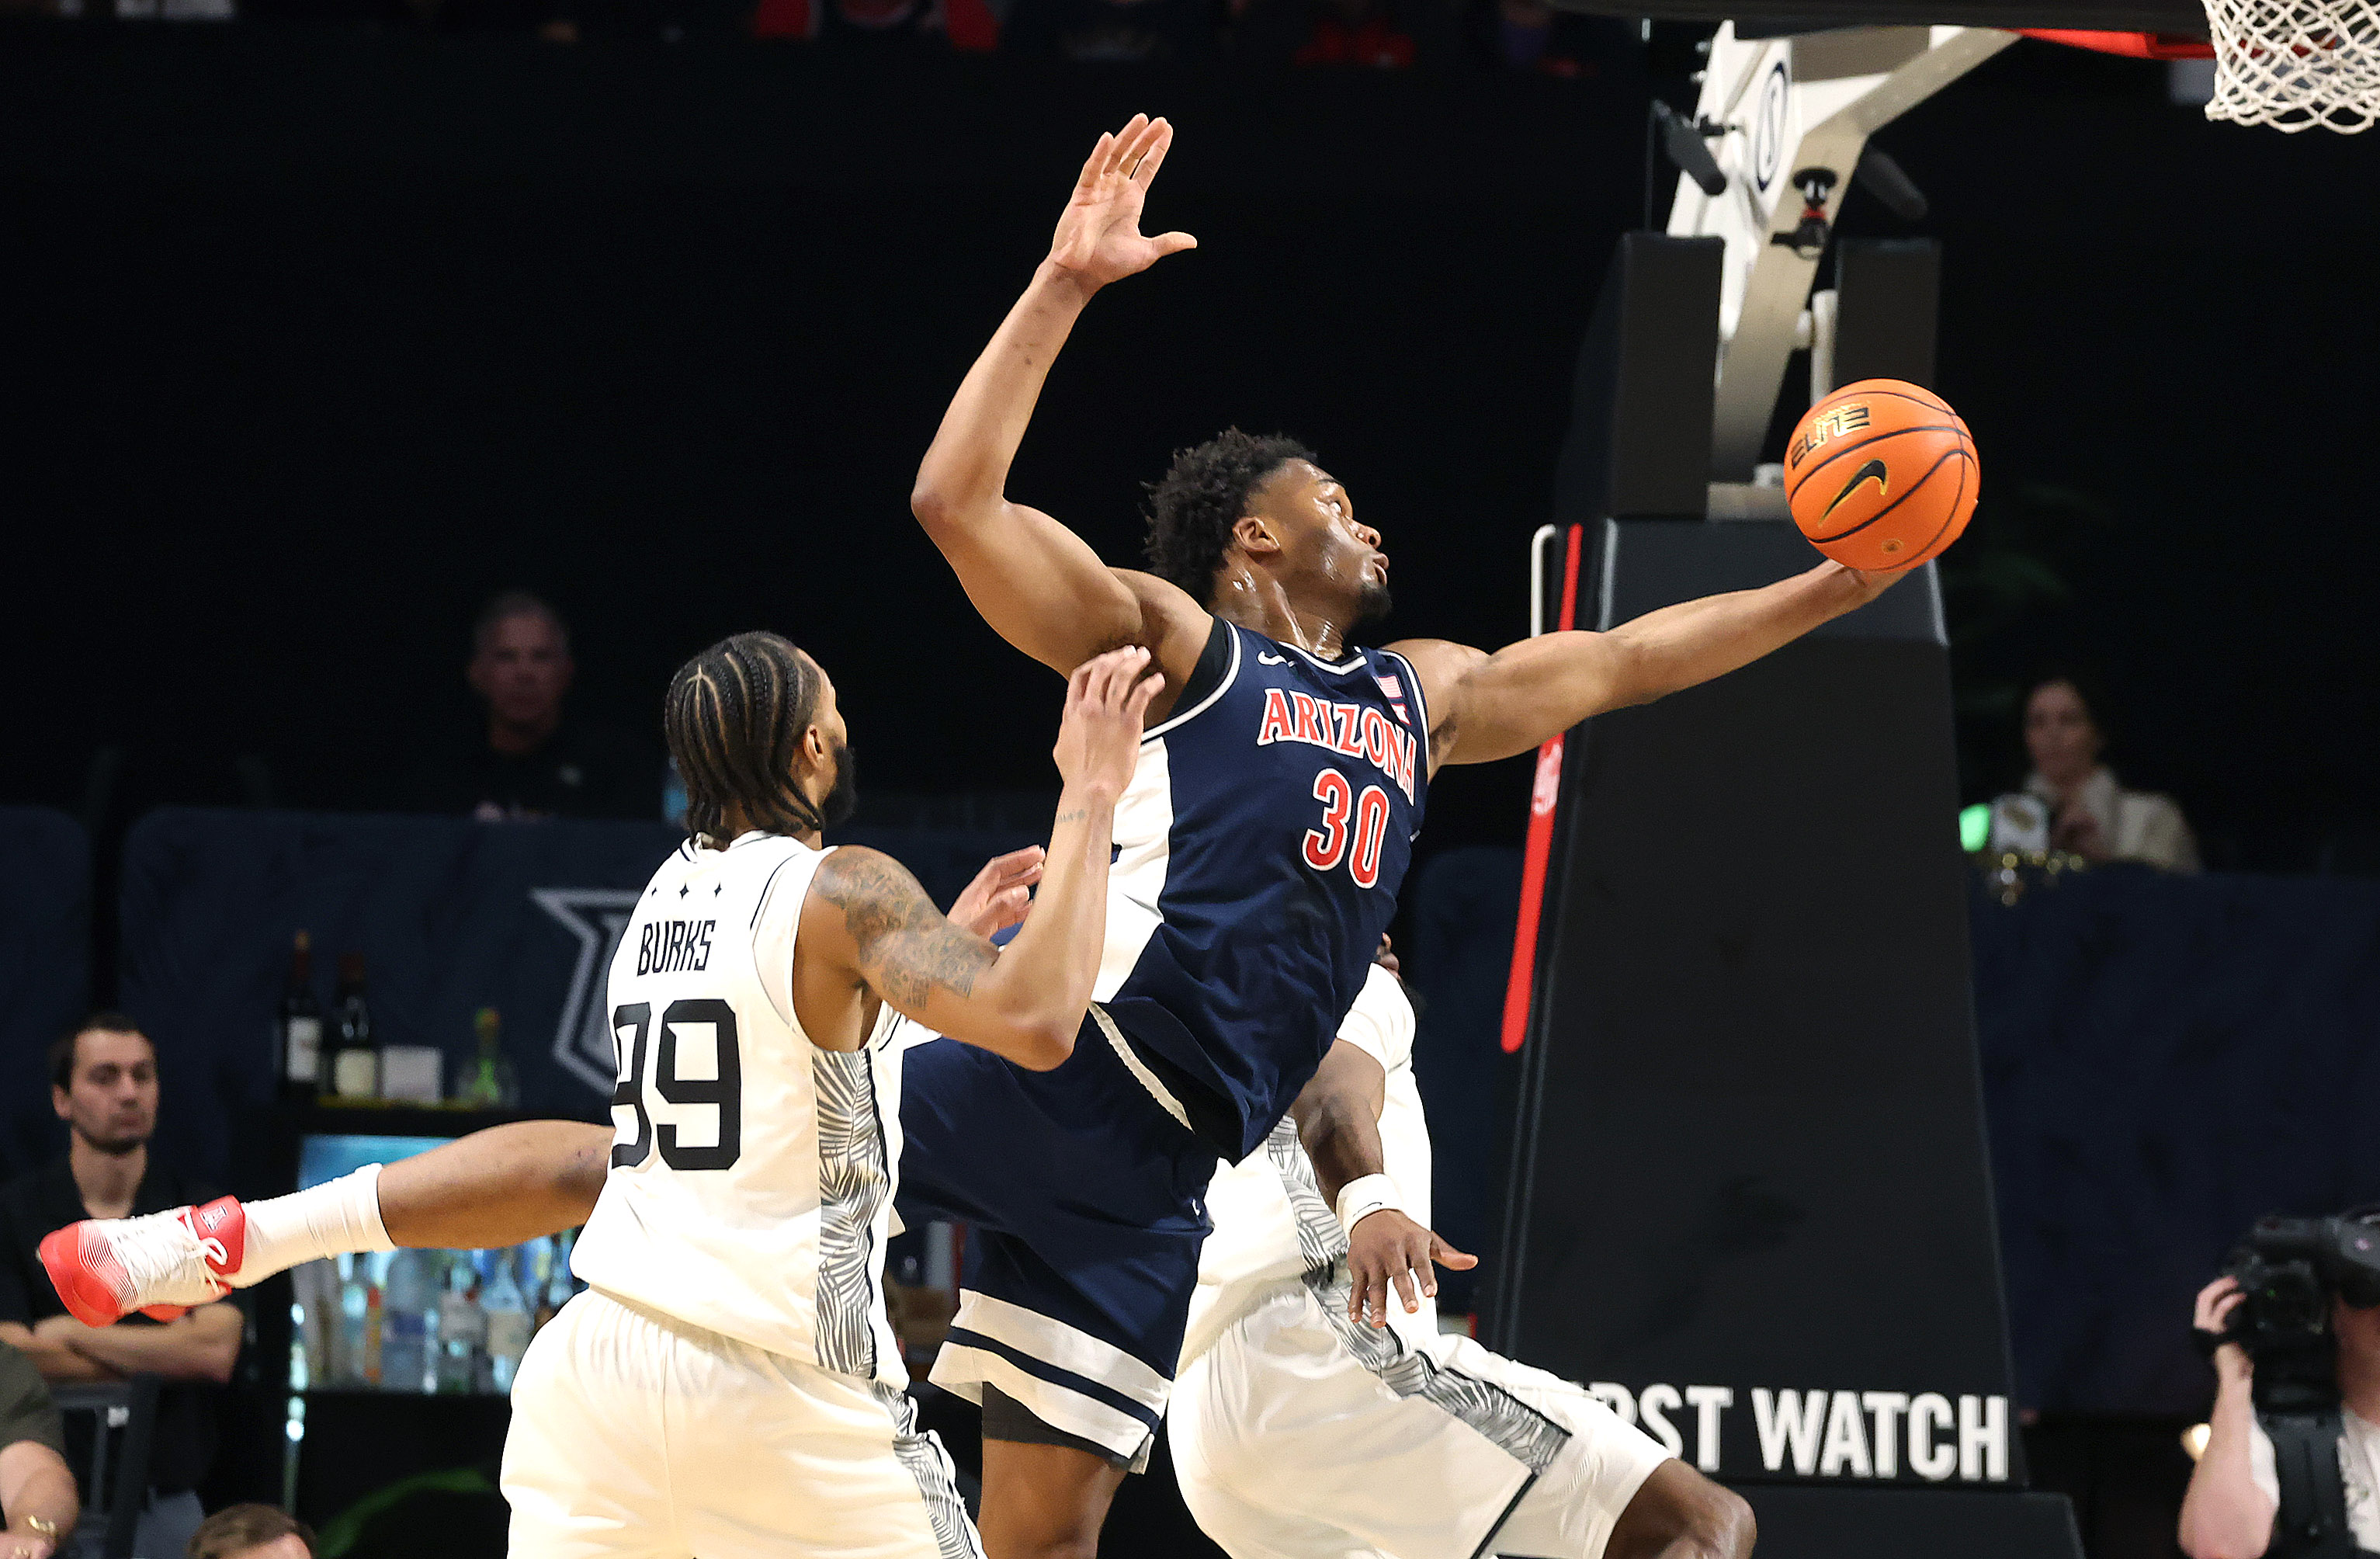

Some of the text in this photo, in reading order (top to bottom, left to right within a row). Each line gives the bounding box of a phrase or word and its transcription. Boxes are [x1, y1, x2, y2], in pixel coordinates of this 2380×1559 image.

[1790, 402, 1872, 470] ELITE
[1257, 688, 1417, 807] ARIZONA
[1302, 767, 1390, 890] 30
[637, 919, 716, 977] BURKS
[1750, 1387, 2010, 1483] WATCH
